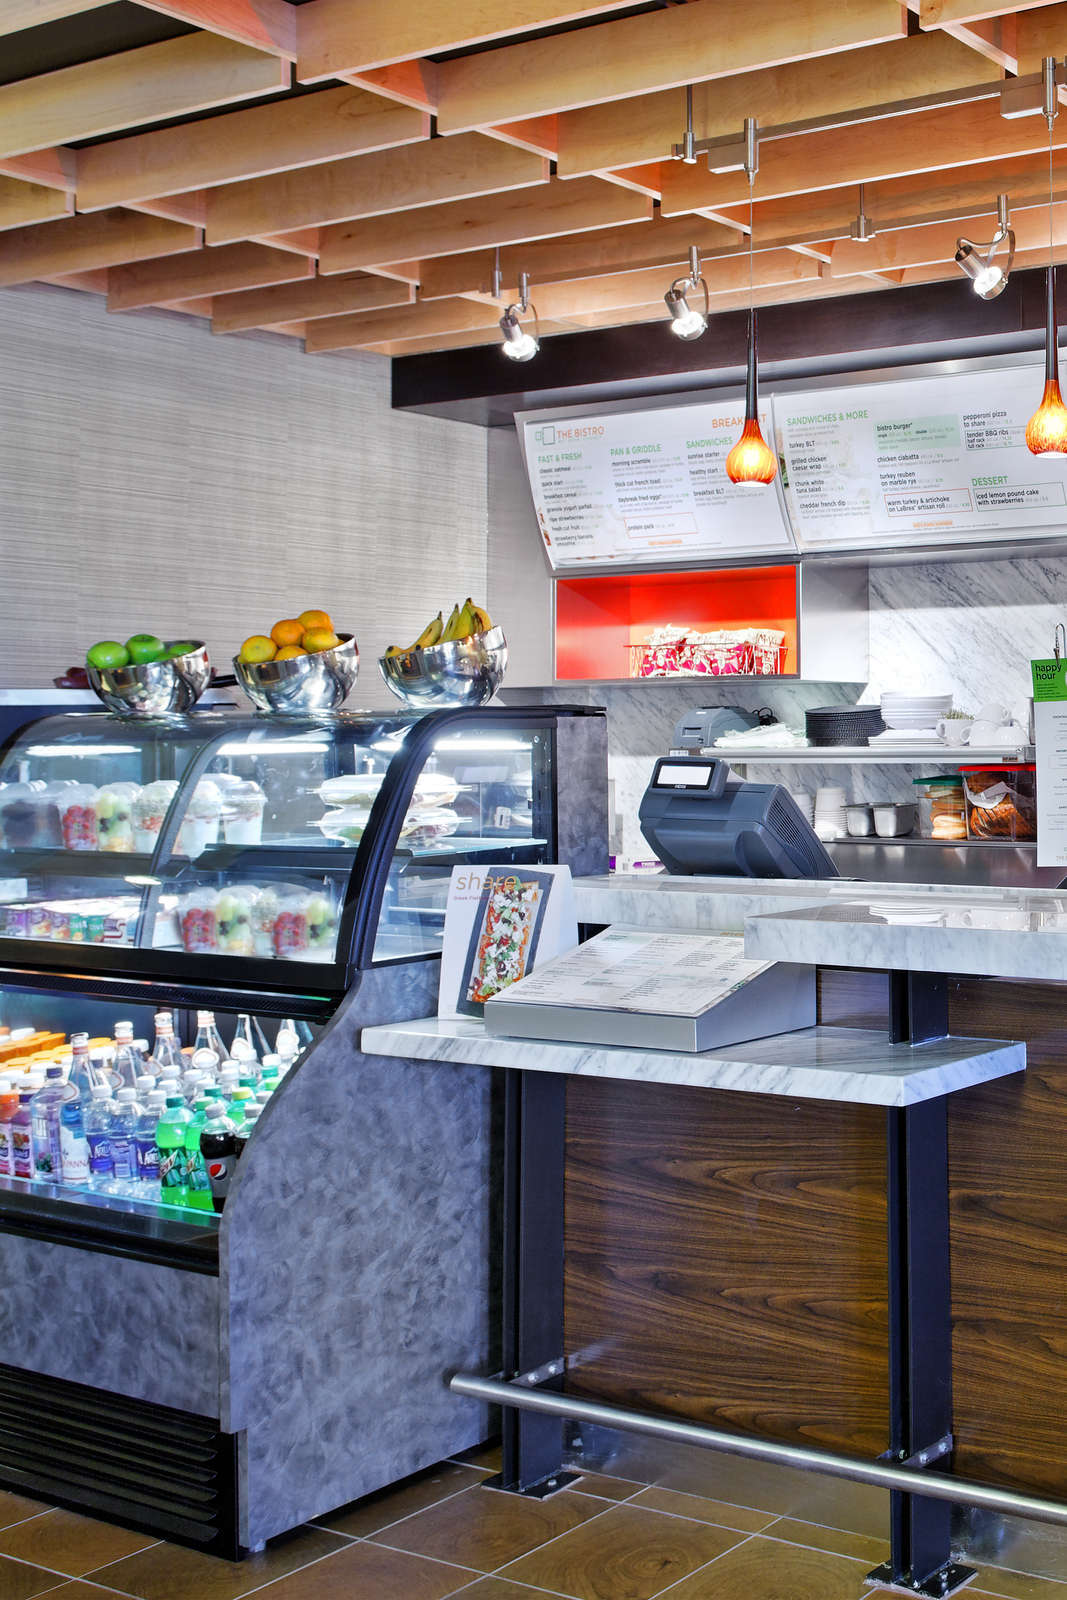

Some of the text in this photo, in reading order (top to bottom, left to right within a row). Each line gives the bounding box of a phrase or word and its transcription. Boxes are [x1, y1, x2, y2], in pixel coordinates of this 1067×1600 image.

[712, 414, 767, 428] BREAKT
[787, 414, 837, 426] SANDWICHES
[846, 410, 868, 419] MORE
[963, 412, 991, 421] pepperoni
[557, 426, 605, 439] THE BISTRO
[687, 437, 733, 448] SANDWICHES
[610, 448, 624, 456] PAN
[632, 444, 662, 454] GRIDDLE
[538, 455, 553, 463] FAST
[561, 452, 582, 460] FRESH
[972, 476, 1008, 486] DESSERT
[977, 492, 987, 500] iced
[1008, 490, 1025, 498] pound
[1035, 664, 1061, 672] happy
[456, 872, 516, 890] share
